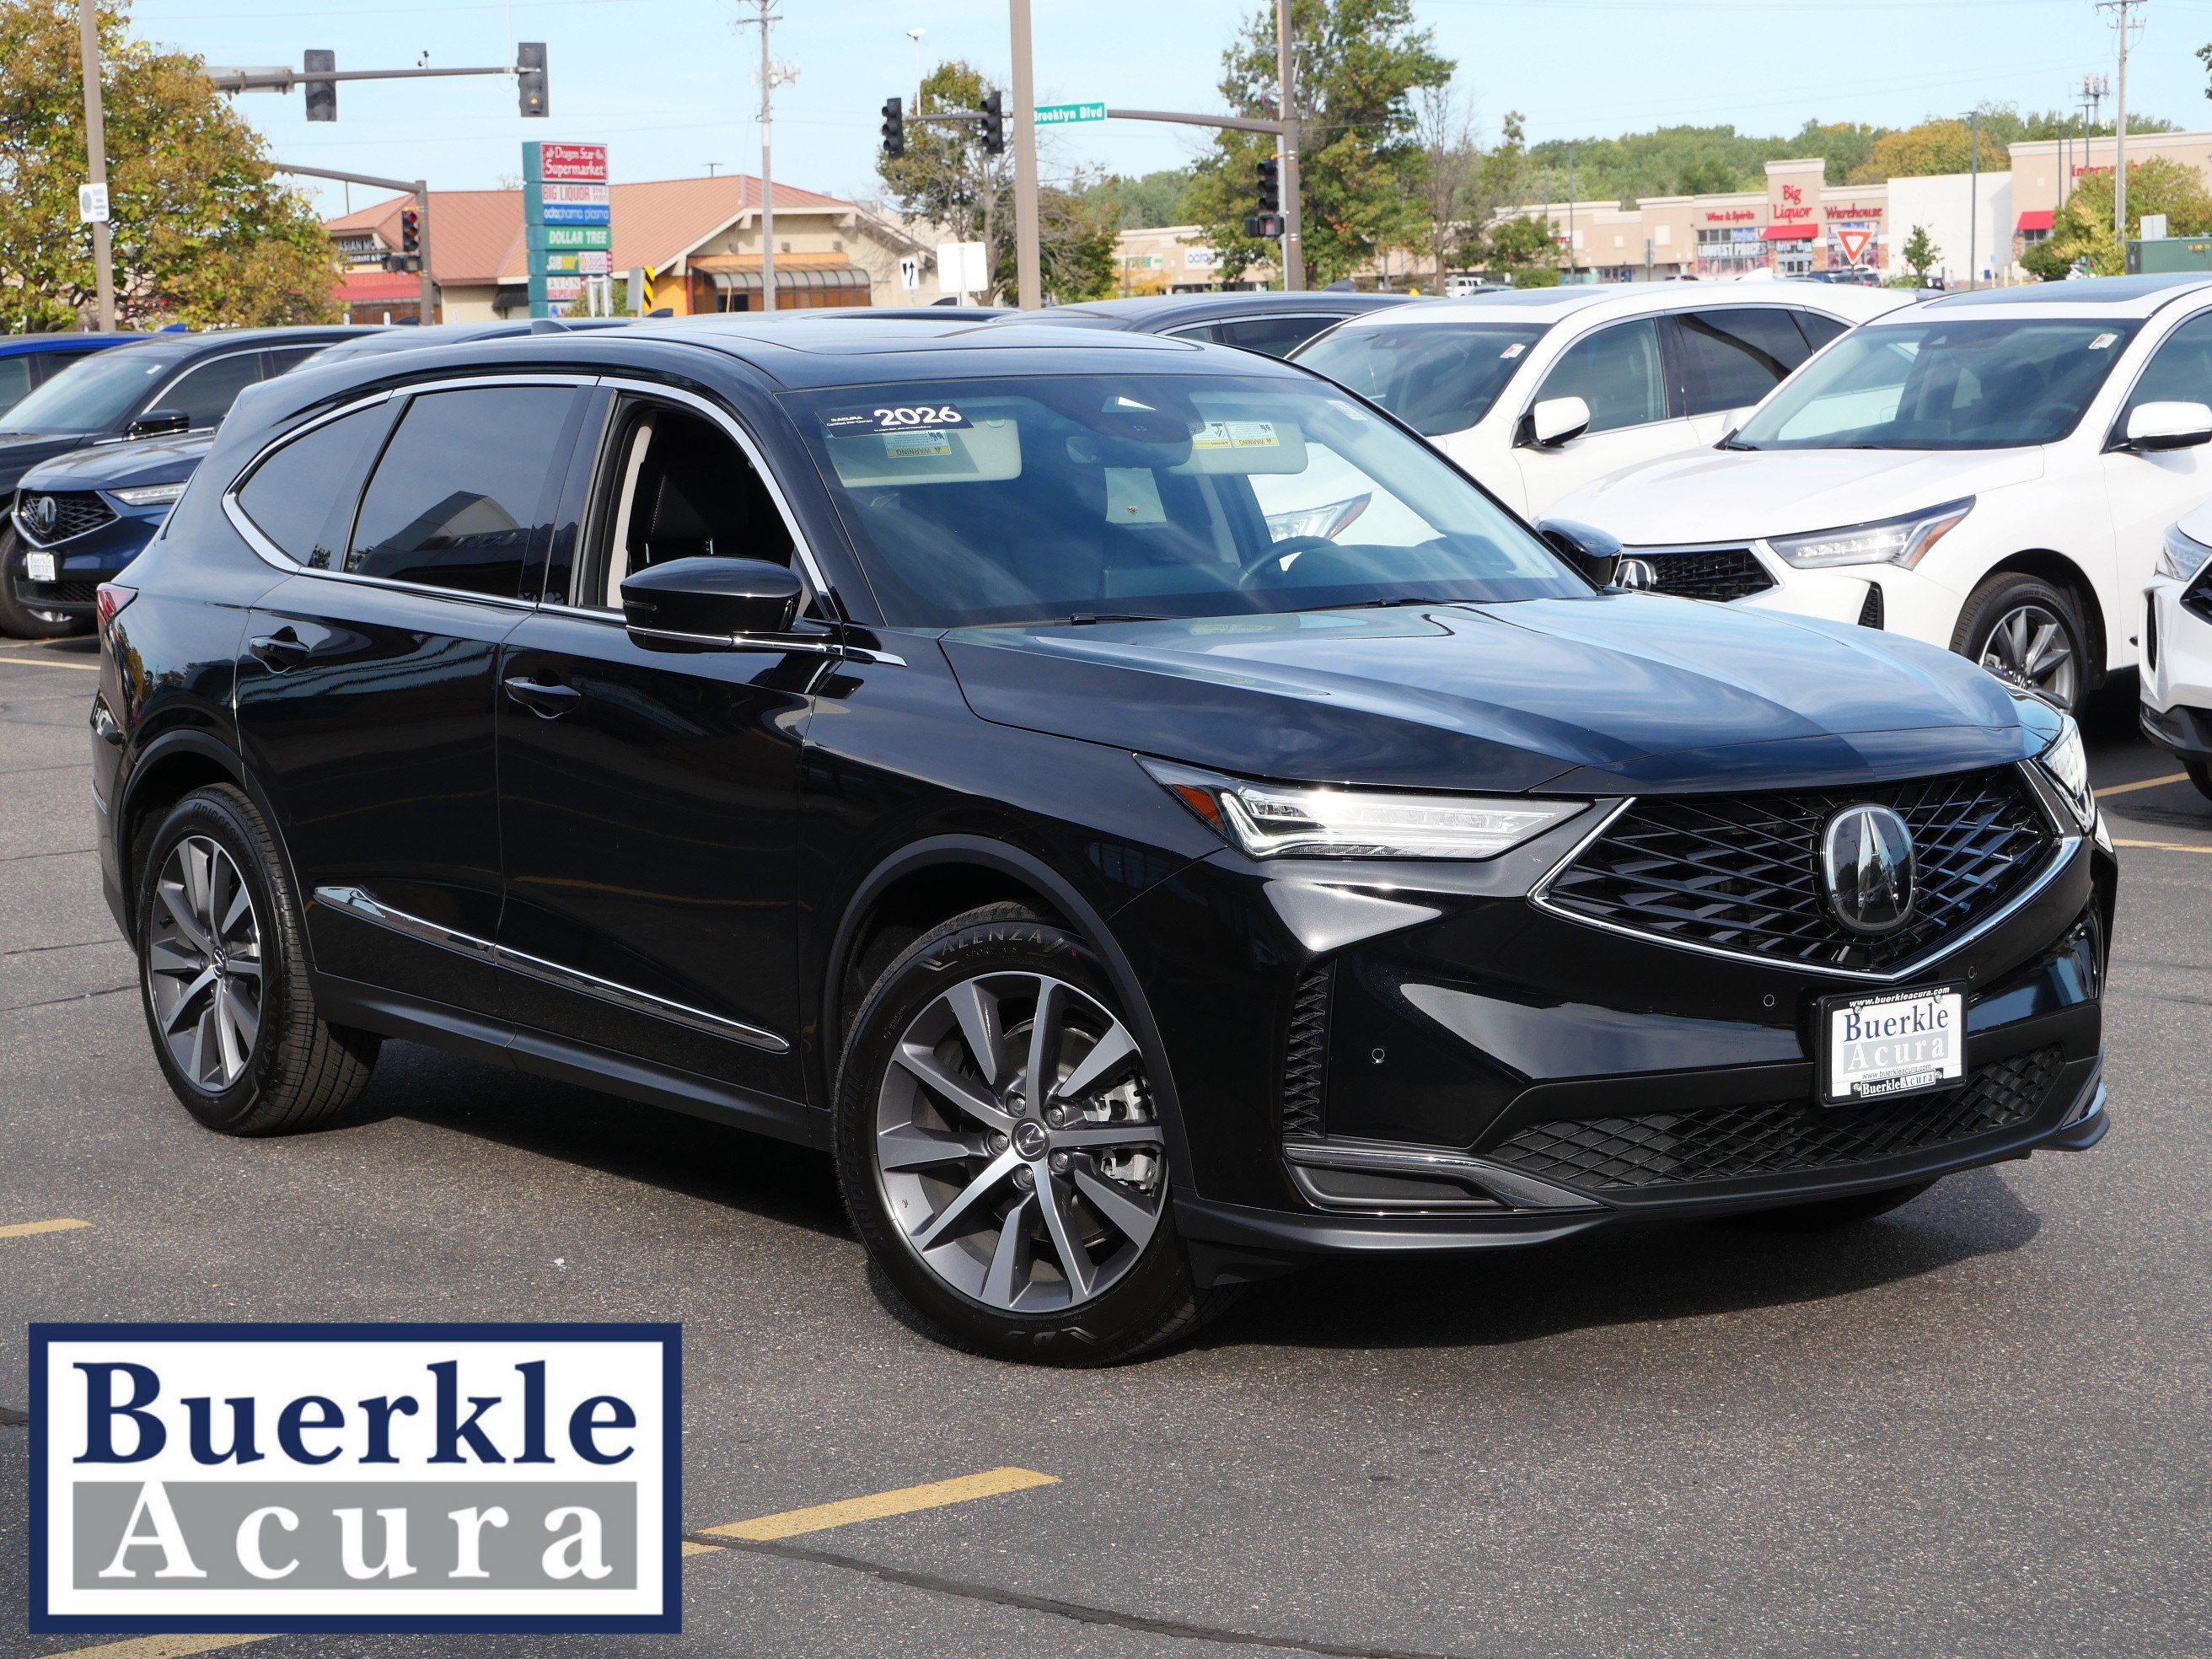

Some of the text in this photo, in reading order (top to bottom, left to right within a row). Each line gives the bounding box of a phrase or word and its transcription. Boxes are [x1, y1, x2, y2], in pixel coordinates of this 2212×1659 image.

[1034, 106, 1103, 123] Brooklyn Blvd
[555, 147, 593, 161] Dragon Star
[545, 158, 604, 177] Supermarket
[544, 186, 590, 201] BIG LIQUOR
[1782, 185, 1802, 205] Big
[1773, 204, 1812, 223] Liquor
[1824, 203, 1882, 219] Warehouse
[549, 231, 607, 244] DOLLAR TREE
[546, 255, 578, 271] SUBWAY
[873, 406, 963, 427] 2026
[896, 447, 932, 455] WARNING
[941, 927, 1043, 957] ALENZA
[1850, 986, 1950, 1008] www.buerkleacura.com
[1844, 1002, 1948, 1042] Buerkle
[1848, 1037, 1944, 1071] Acura
[1862, 1064, 1931, 1080] www.buerkleacura.com
